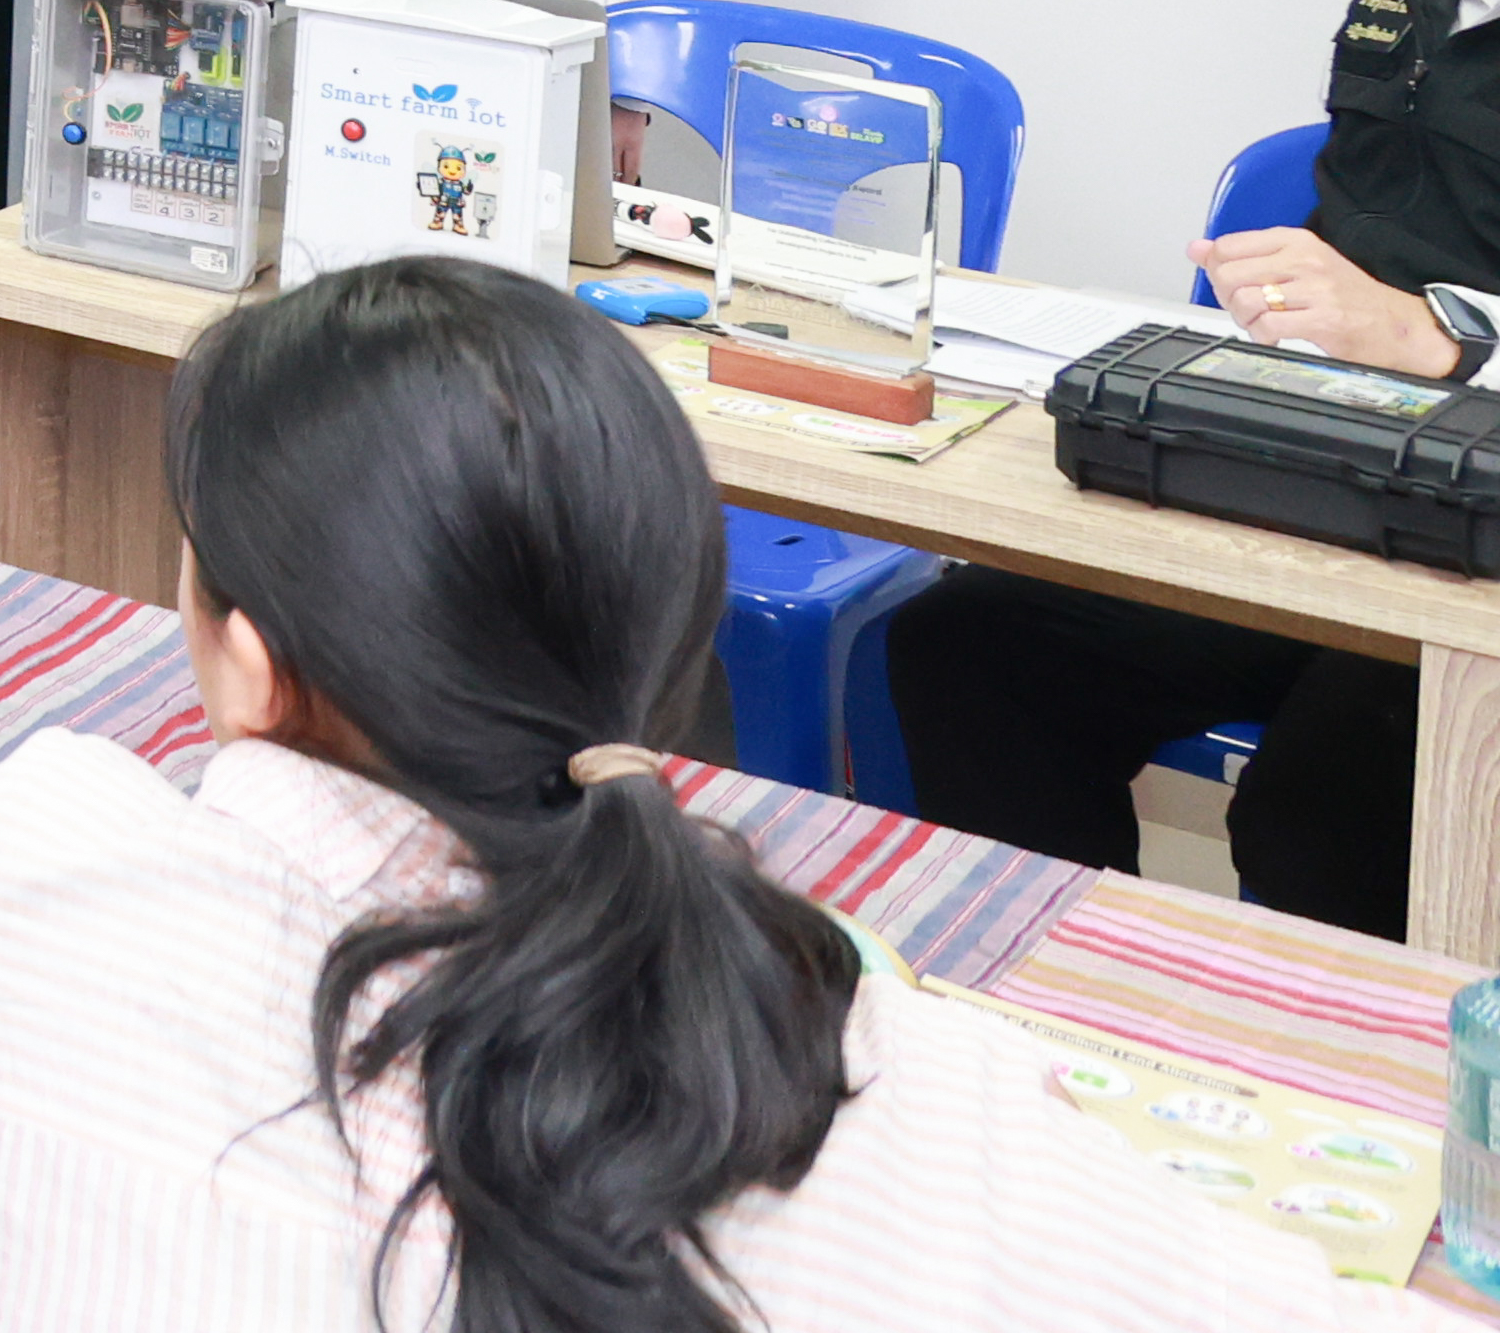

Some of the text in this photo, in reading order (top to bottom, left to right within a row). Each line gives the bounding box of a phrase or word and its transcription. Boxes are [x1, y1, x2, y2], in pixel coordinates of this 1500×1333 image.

[321, 83, 507, 128] Smart farm iot
[324, 144, 392, 167] M.Switch
[159, 206, 170, 217] 4
[184, 208, 195, 218] 3
[208, 212, 219, 223] 2
[1117, 1048, 1156, 1069] Land
[1159, 1064, 1240, 1094] Allocation
